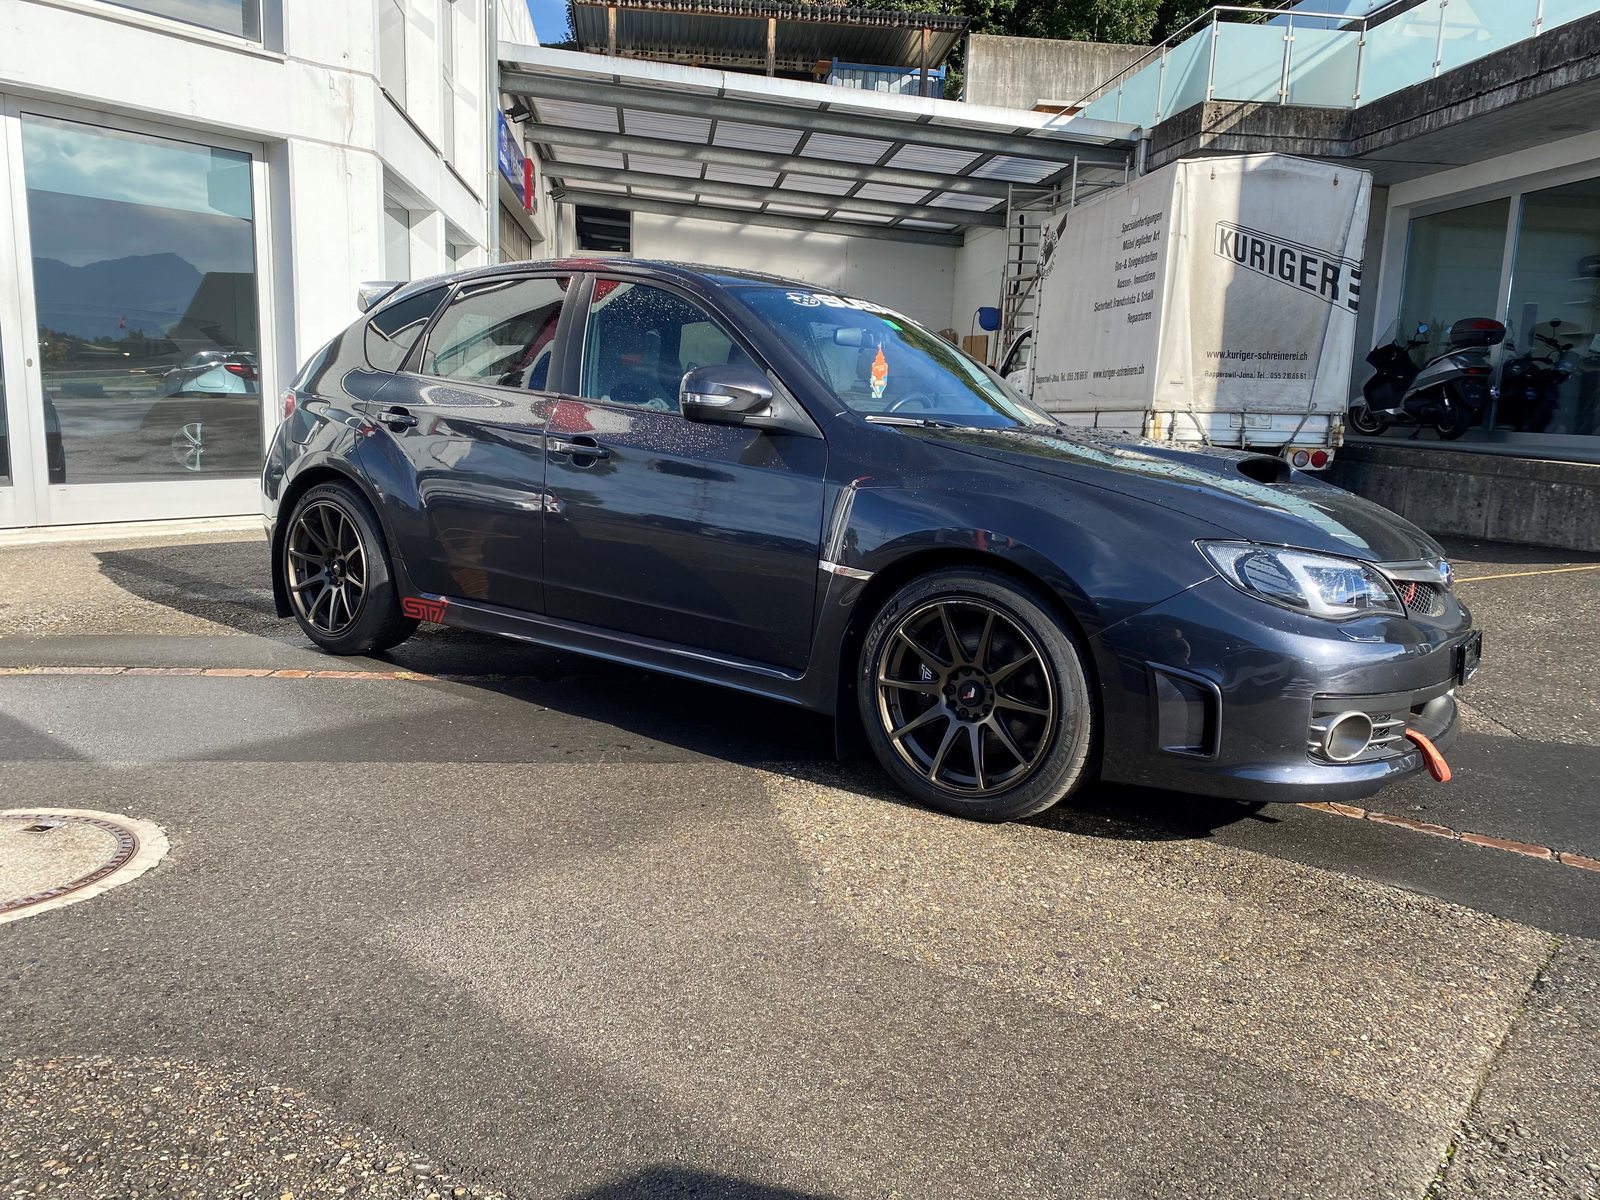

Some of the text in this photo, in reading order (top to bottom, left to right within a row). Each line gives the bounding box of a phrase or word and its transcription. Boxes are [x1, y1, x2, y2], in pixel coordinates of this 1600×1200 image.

[1152, 230, 1160, 242] Art
[1219, 228, 1341, 301] KURIGER
[1206, 350, 1308, 361] www.kuriger-schreinerei.ch
